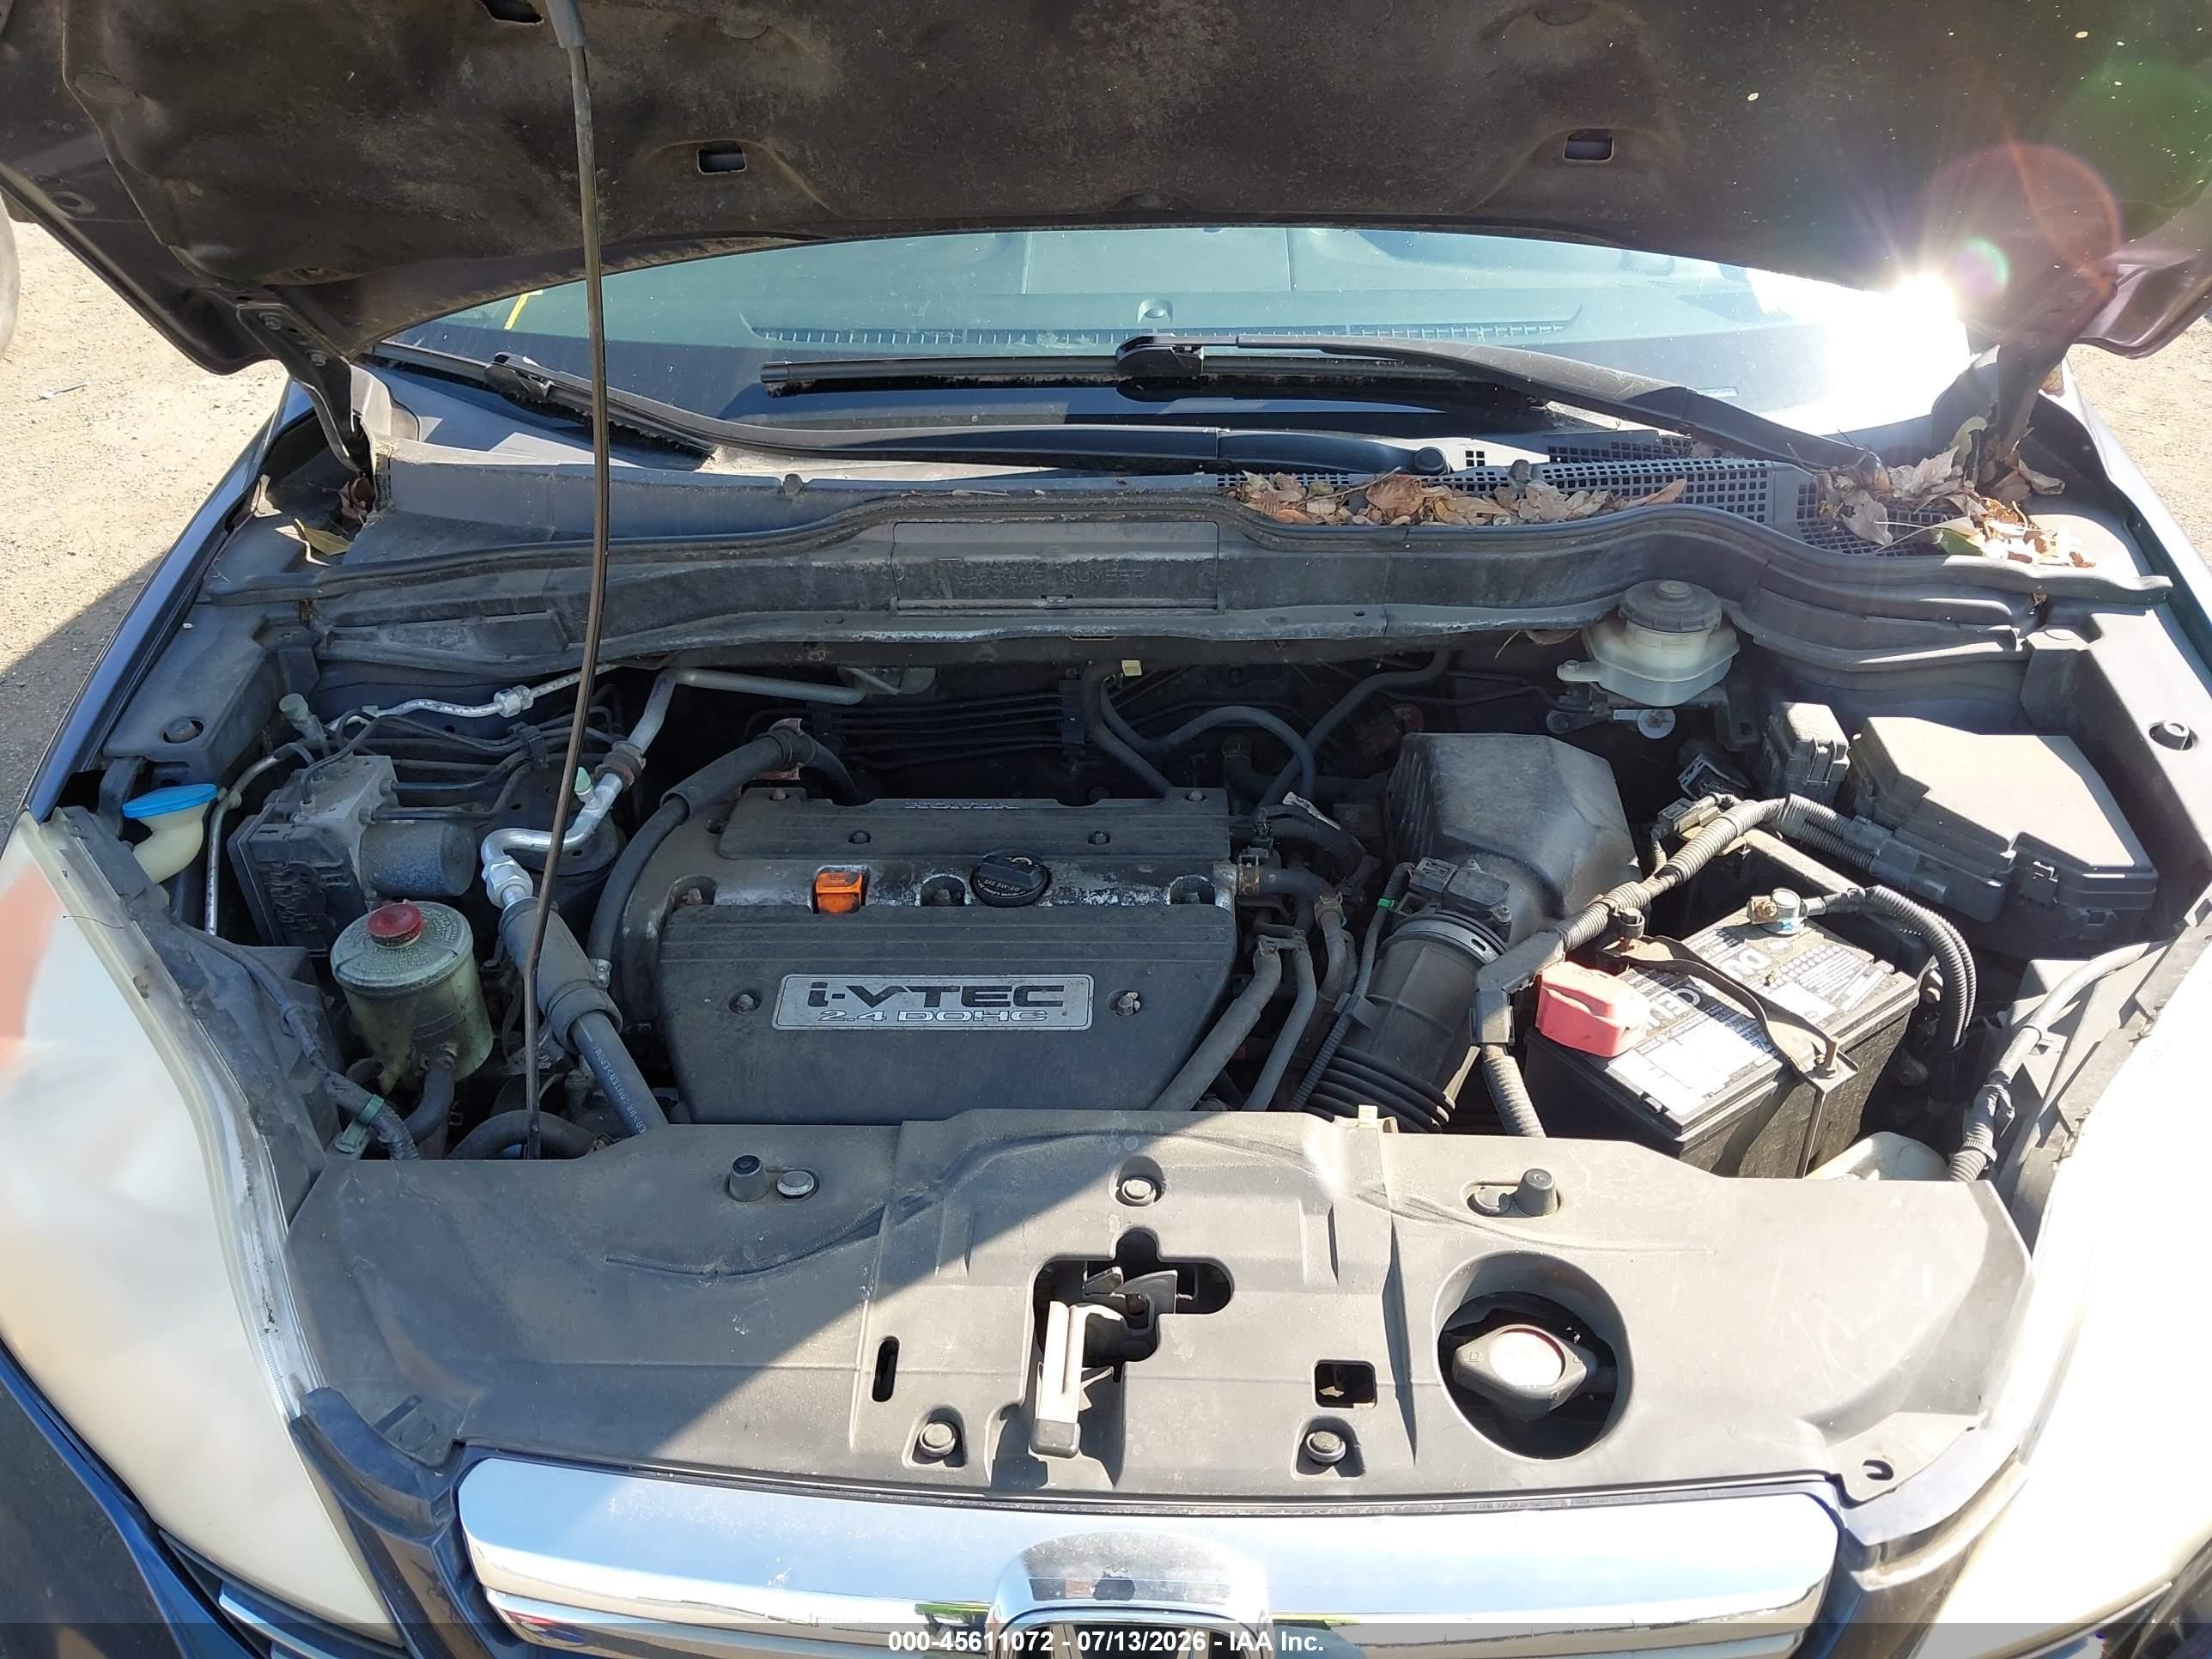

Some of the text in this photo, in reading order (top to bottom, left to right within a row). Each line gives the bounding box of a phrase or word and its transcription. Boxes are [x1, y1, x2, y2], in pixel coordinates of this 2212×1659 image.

[1062, 568, 1146, 584] NUMBER
[904, 800, 1020, 810] HONDA
[807, 981, 1065, 1008] i-VTEC
[818, 1010, 1048, 1022] 2.4 DOHC
